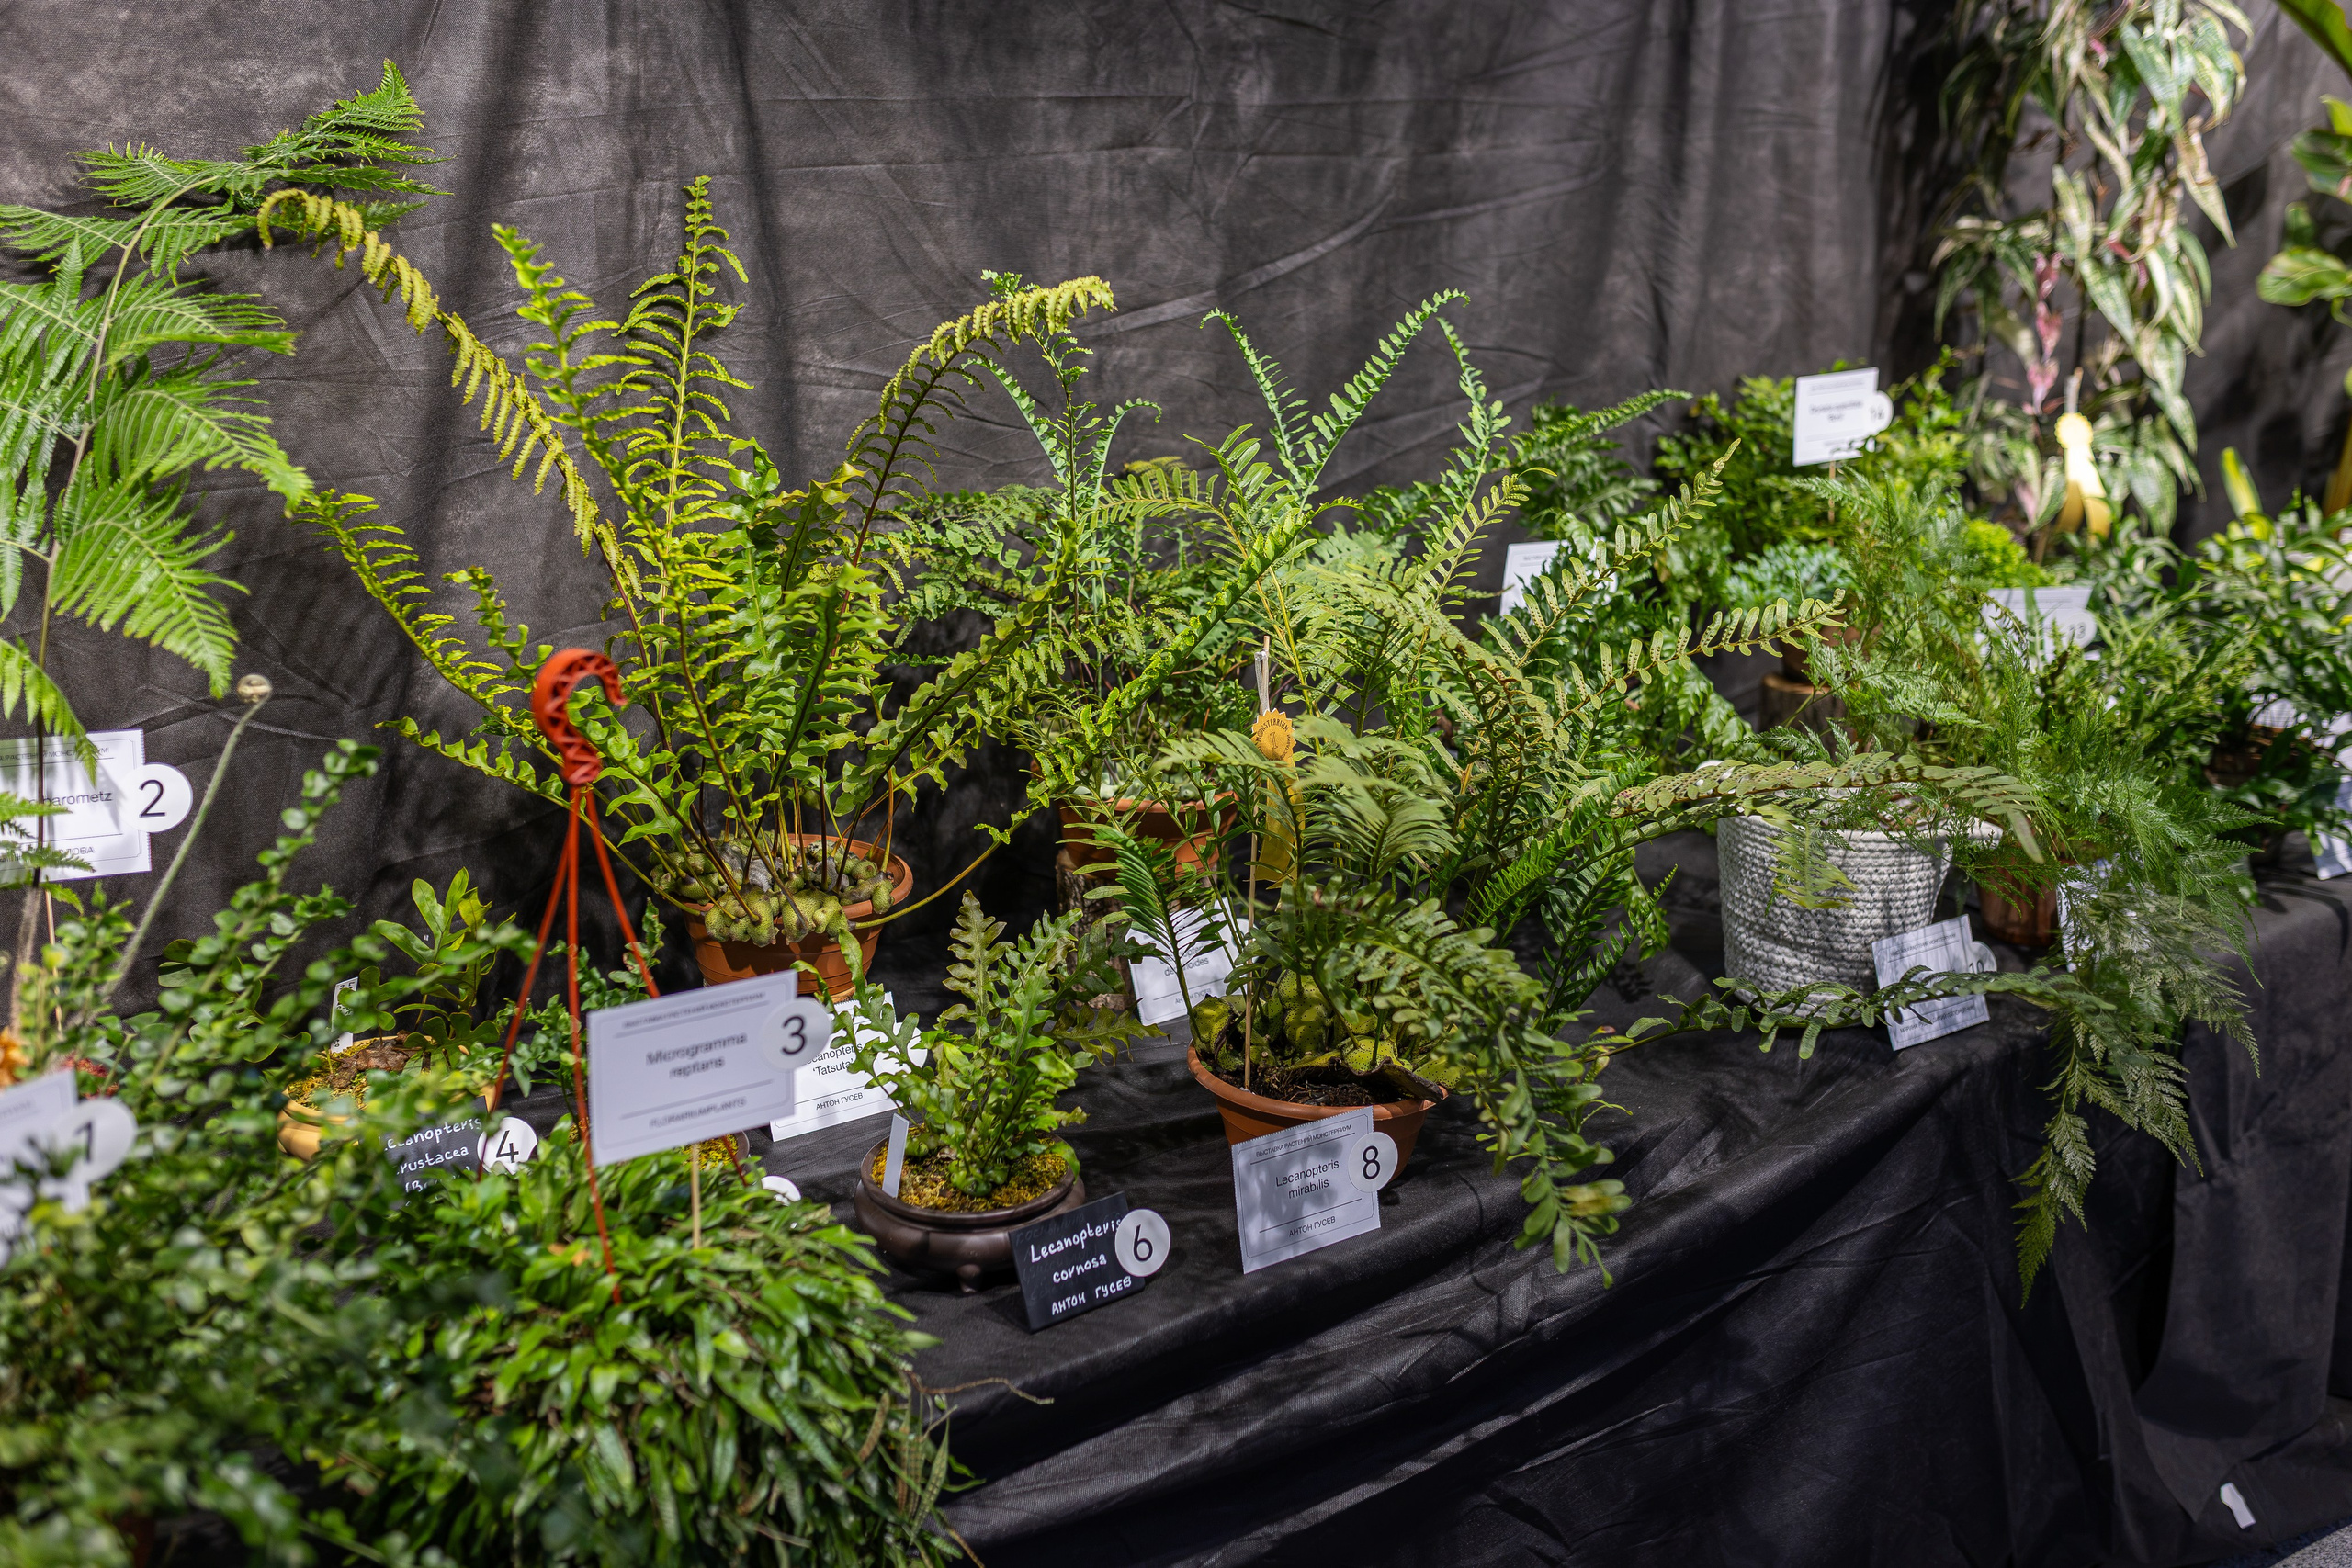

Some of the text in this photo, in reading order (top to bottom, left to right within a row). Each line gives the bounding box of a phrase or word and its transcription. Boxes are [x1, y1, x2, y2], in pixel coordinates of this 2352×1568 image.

[139, 779, 166, 818] 2
[645, 1032, 748, 1066] Microgramma
[780, 1014, 808, 1055] 3
[816, 1092, 864, 1111] АНТОН ГУСЕВ
[74, 1121, 94, 1163] 1
[496, 1130, 519, 1164] 4
[1255, 1124, 1352, 1157] ВЫСТАВКА РАСТЕНИЙ МОНСТЕРРИУМ
[1275, 1158, 1340, 1187] Lecanopteris
[1363, 1145, 1381, 1180] 8
[1288, 1178, 1329, 1199] mirabilis
[1133, 1224, 1154, 1262] 6
[1289, 1215, 1336, 1237] АНТОН ГУСЕВ
[1051, 1275, 1132, 1316] АНТОН ГУСЕВ
